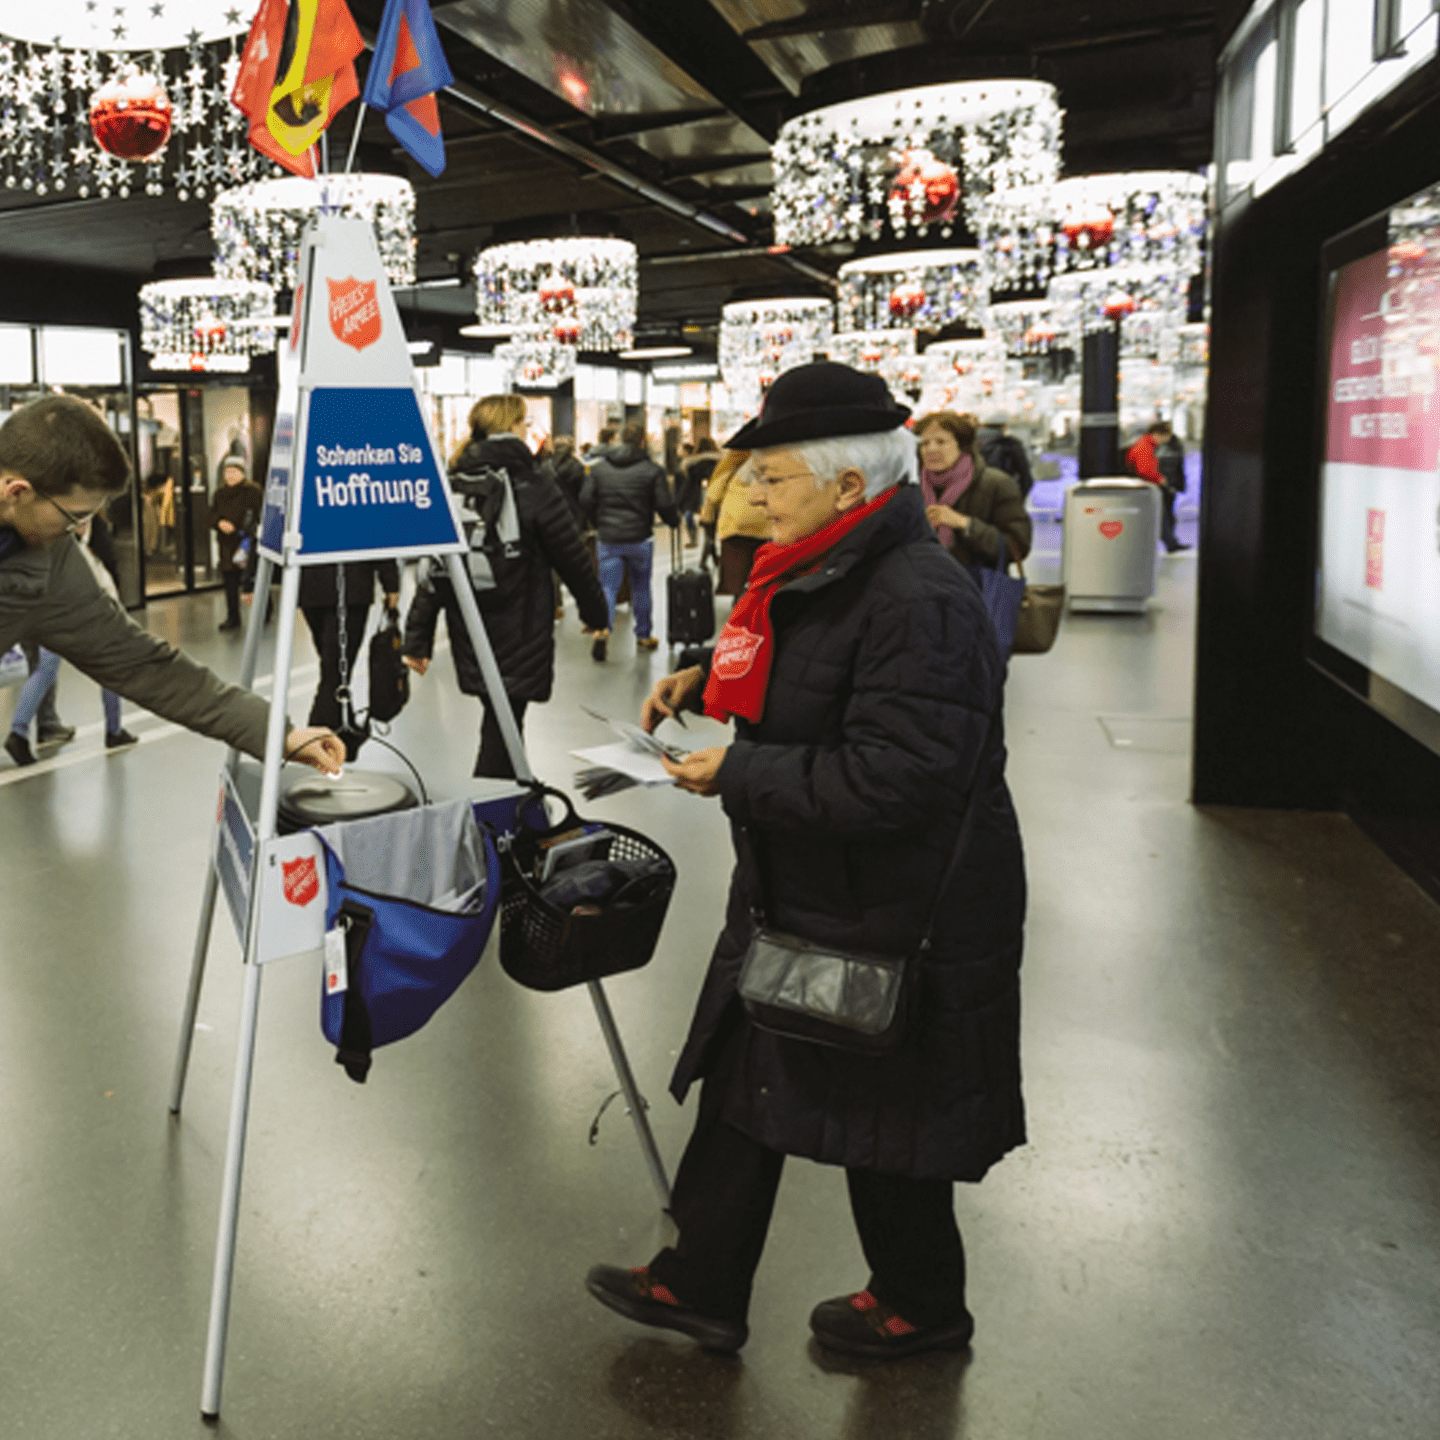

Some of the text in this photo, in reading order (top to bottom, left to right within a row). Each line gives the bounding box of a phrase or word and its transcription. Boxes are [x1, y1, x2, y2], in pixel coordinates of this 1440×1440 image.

[316, 442, 423, 467] Schenken Sie
[315, 472, 432, 509] Hoffnung
